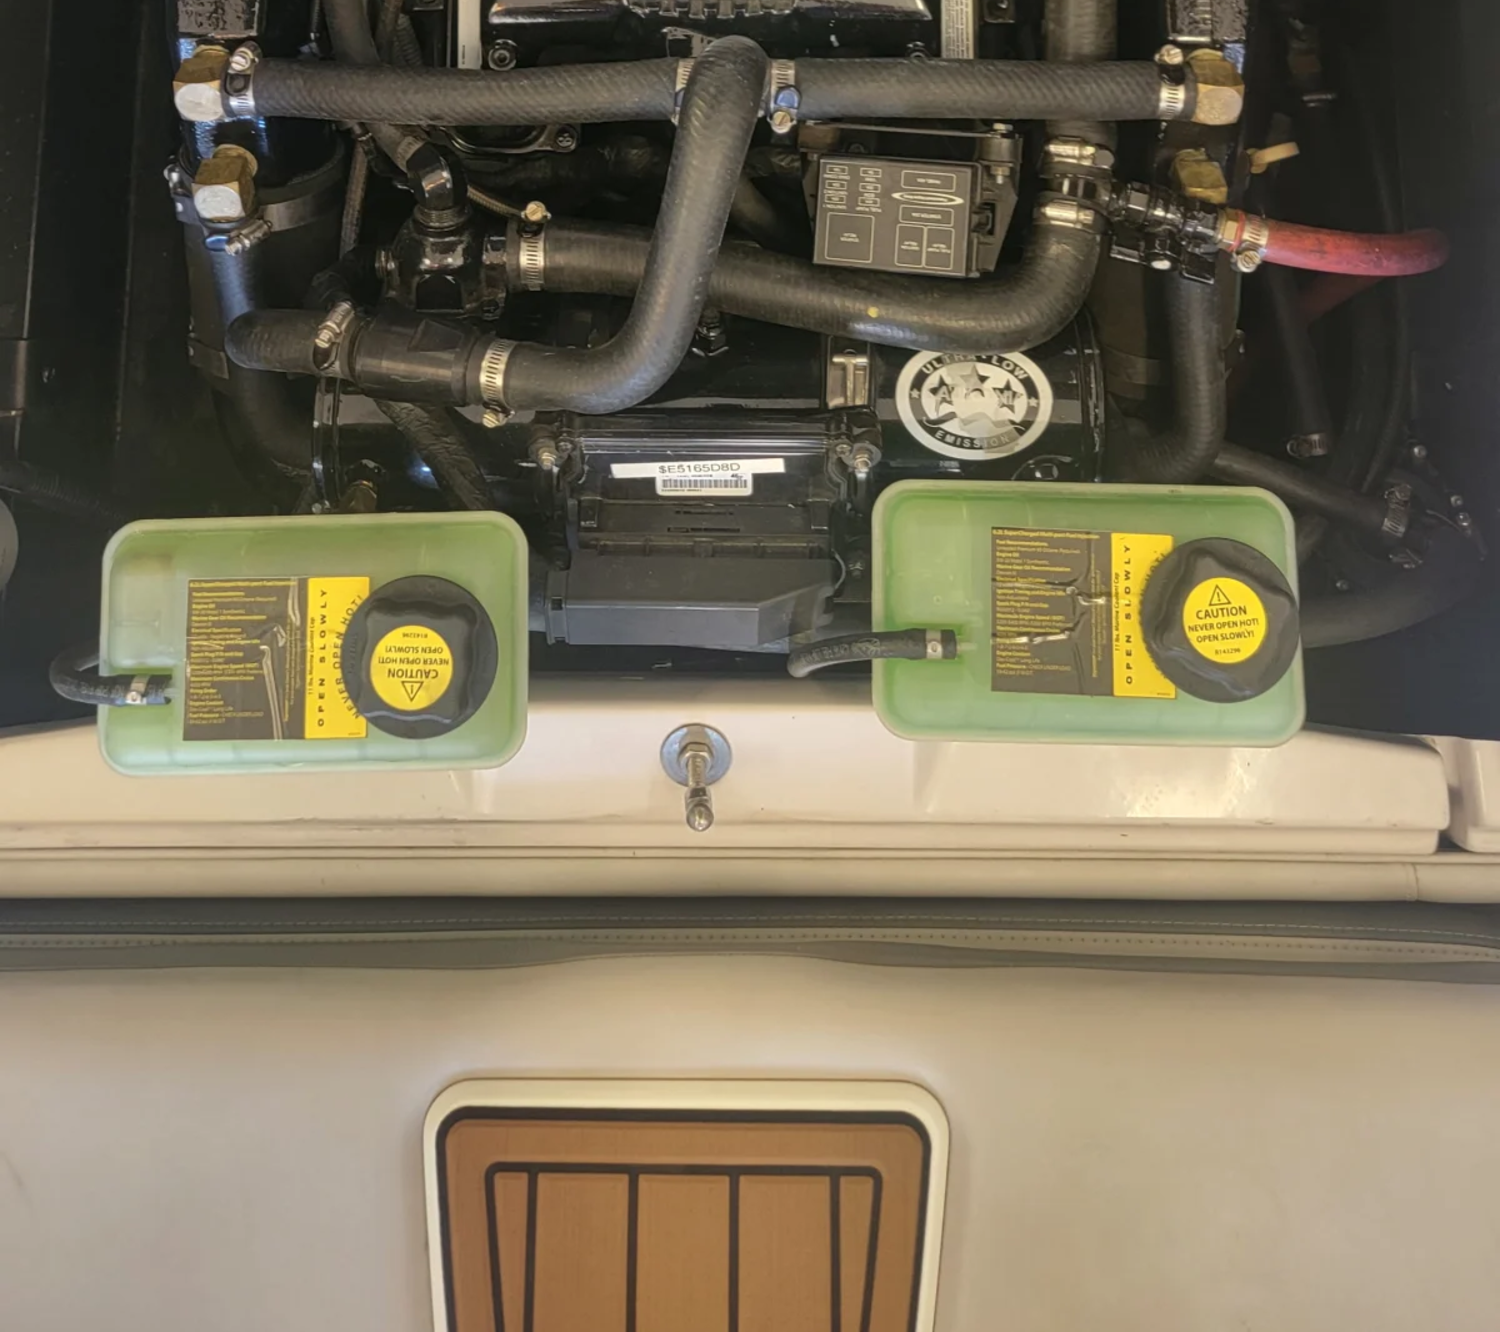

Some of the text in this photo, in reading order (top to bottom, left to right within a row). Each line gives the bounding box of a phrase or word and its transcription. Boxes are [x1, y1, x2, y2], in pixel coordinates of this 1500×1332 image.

[920, 354, 1029, 380] ULTRA LOW
[934, 429, 1010, 449] EMISSION
[340, 595, 363, 627] HOT!
[1195, 605, 1247, 620] CAUTION
[1188, 618, 1259, 632] NEVER OPEN HOT!
[1196, 630, 1254, 643] OPEN SLOWLY!
[318, 589, 327, 727] OPEN SLOWLY
[333, 631, 344, 670] OPEN
[385, 645, 444, 654] OPEN SLOWLY!
[399, 657, 421, 665] OPEN
[423, 658, 449, 666] NEVER
[1125, 634, 1133, 685] OPEN
[387, 668, 439, 679] CAUTION
[335, 678, 361, 719] NEVER
